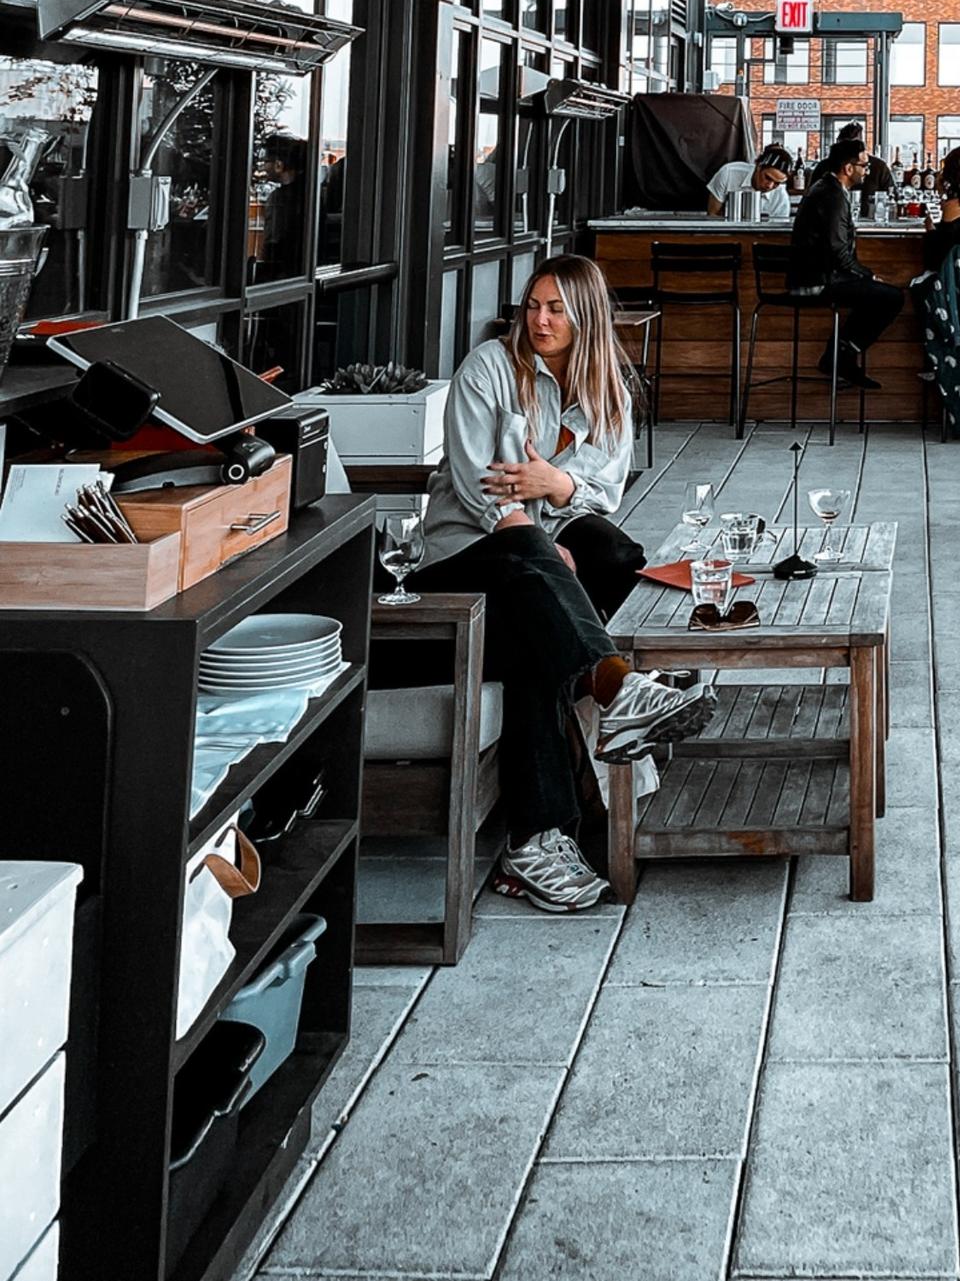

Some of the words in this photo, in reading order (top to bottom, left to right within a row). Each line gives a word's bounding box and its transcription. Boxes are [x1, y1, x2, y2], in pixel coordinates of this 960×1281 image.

[782, 2, 808, 28] EXIT
[779, 102, 795, 110] FIRE
[797, 102, 818, 110] DOOR
